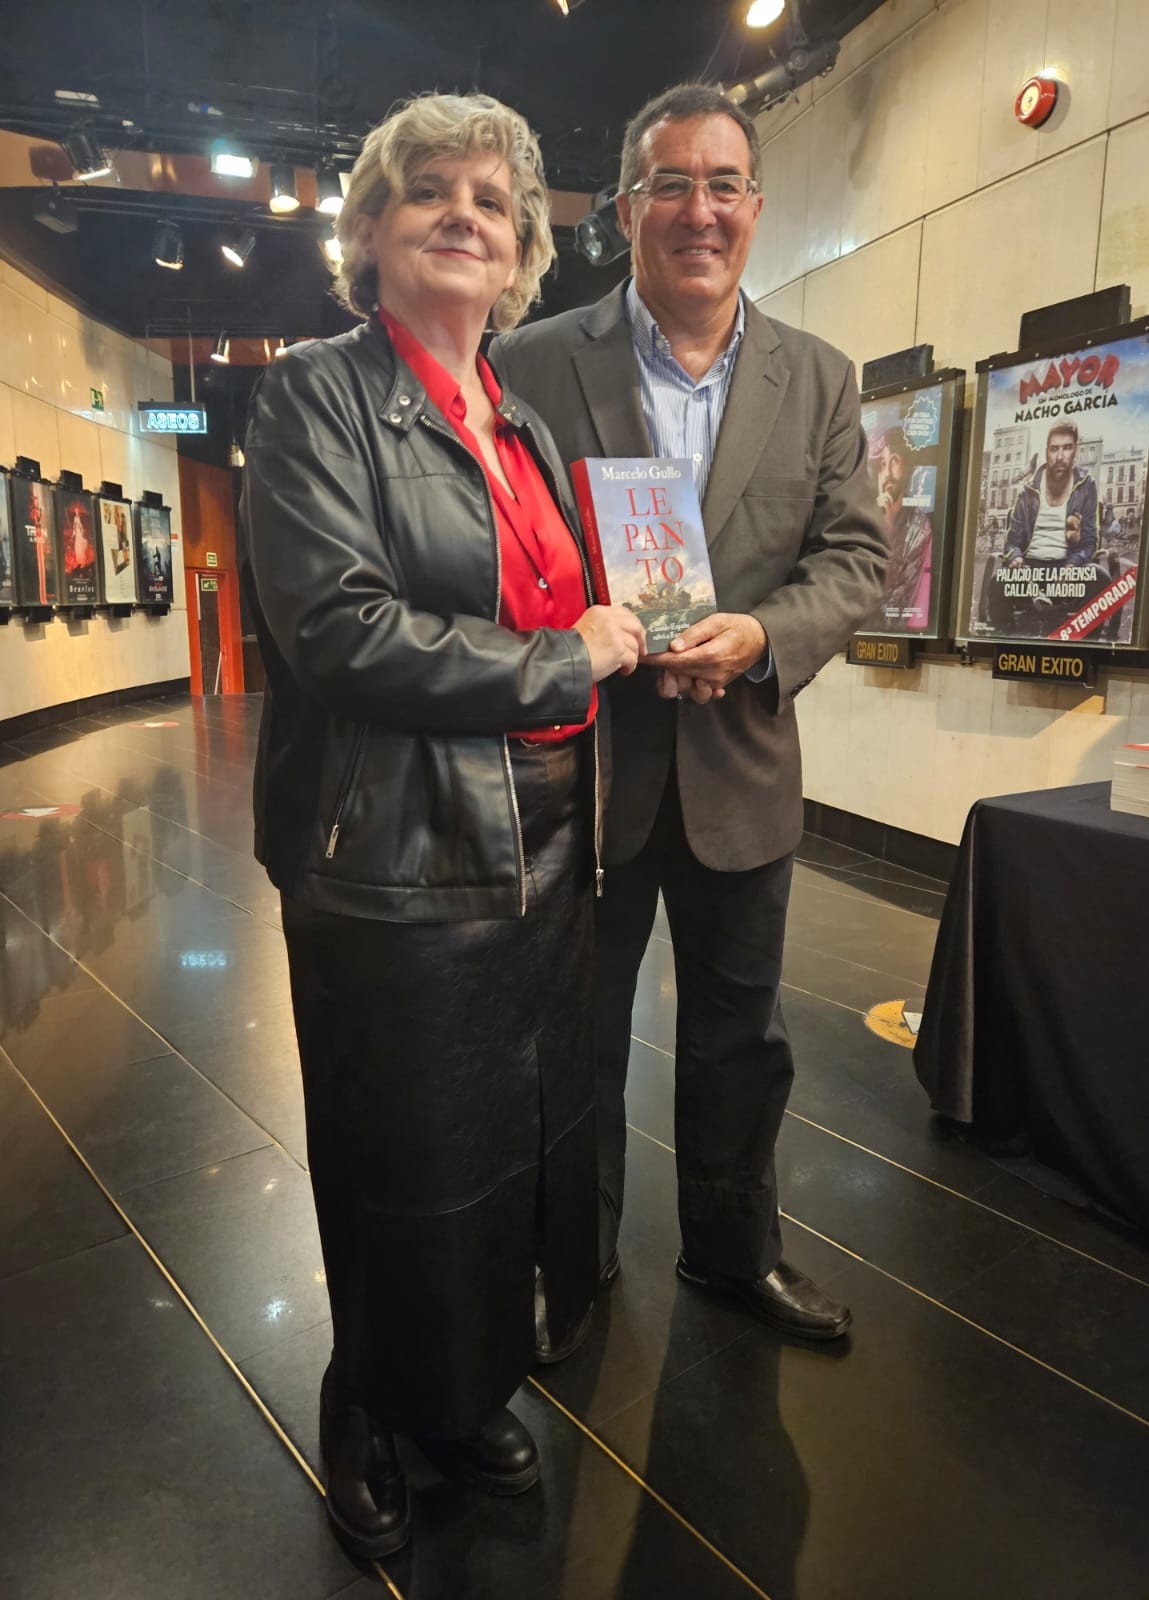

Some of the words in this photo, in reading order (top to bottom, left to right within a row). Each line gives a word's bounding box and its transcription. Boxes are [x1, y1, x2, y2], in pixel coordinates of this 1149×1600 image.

[1019, 353, 1119, 405] MAYOR
[1015, 404, 1061, 423] NACHO
[1063, 390, 1118, 415] GARCÍA
[147, 412, 199, 430] ASEOS
[602, 465, 648, 480] Marcelo
[648, 465, 682, 479] Gullo
[625, 487, 673, 516] LE
[622, 521, 685, 552] PAN
[635, 556, 684, 586] TO
[996, 567, 1032, 582] PALACIO
[1032, 568, 1045, 581] DE
[1045, 567, 1059, 581] LA
[1059, 567, 1097, 581] PRENSA
[1004, 583, 1039, 597] CALLAO
[1046, 583, 1086, 597] MADRID
[1070, 574, 1137, 633] TEMPORADA
[857, 640, 877, 659] GRAN
[878, 642, 899, 662] EXITO
[998, 653, 1036, 672] GRAN
[1041, 656, 1083, 677] EXITO
